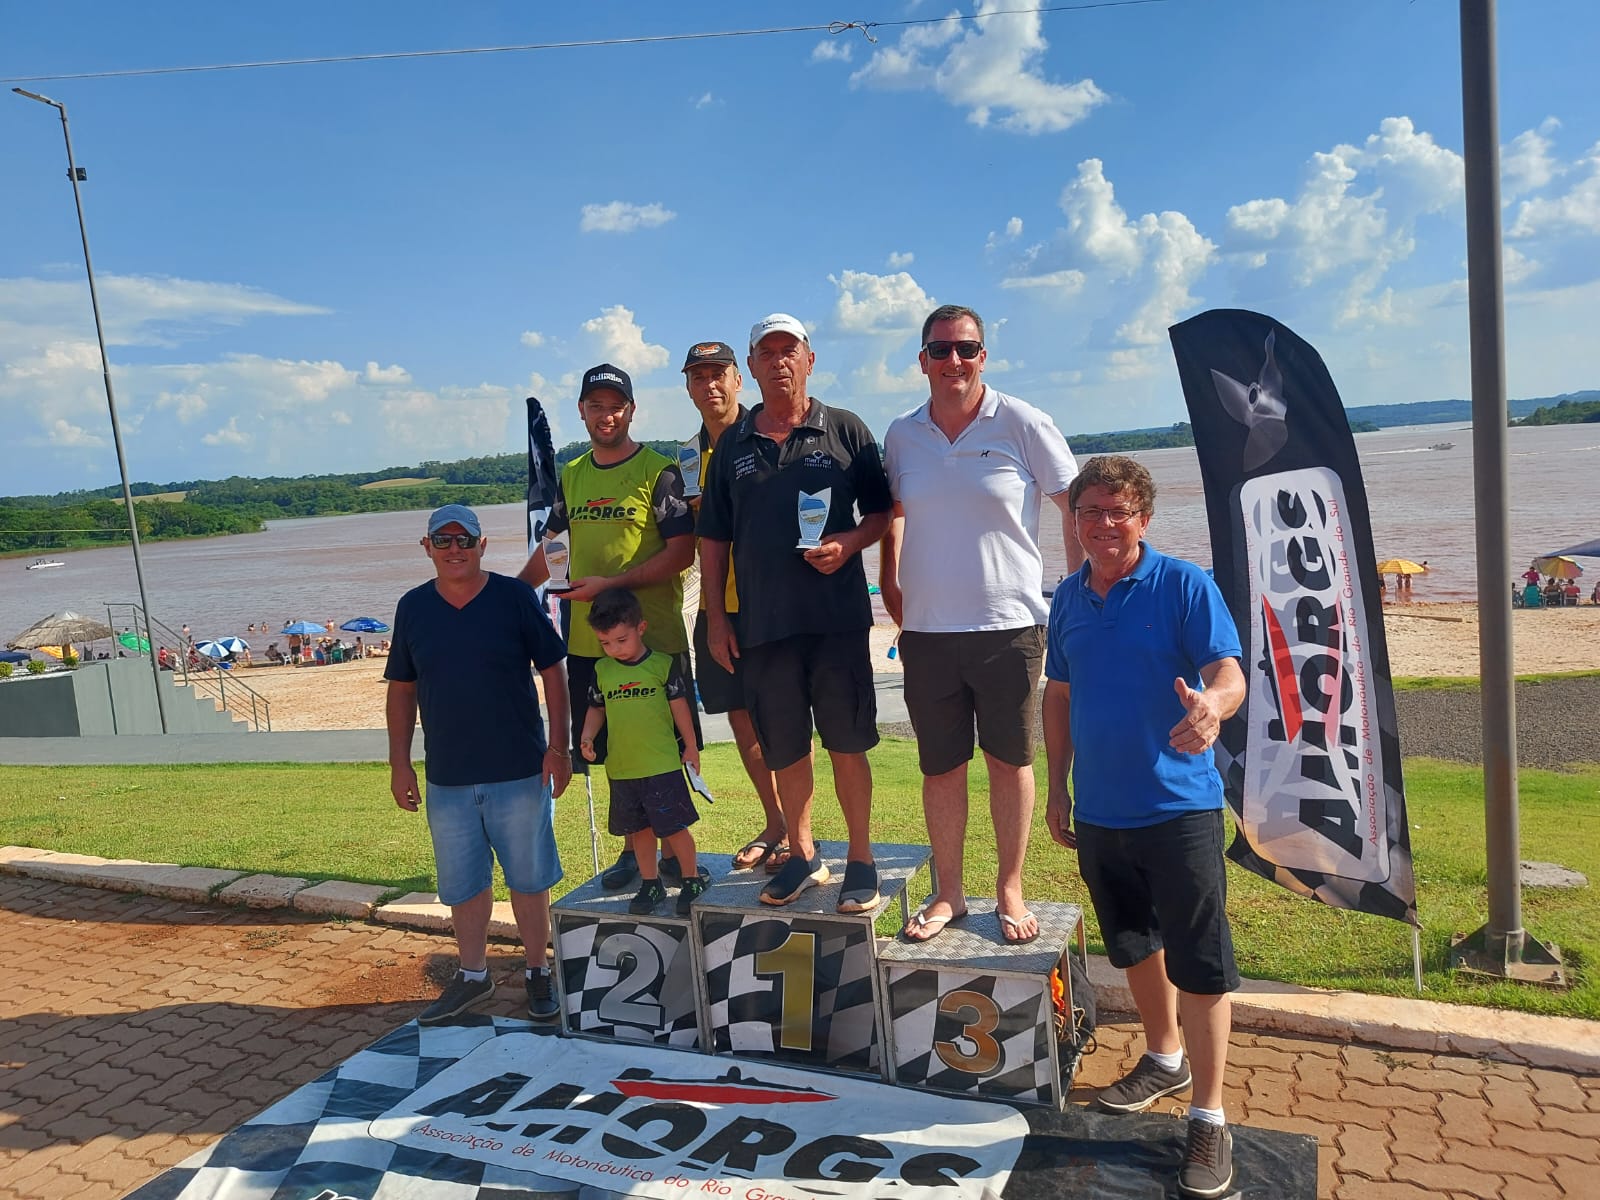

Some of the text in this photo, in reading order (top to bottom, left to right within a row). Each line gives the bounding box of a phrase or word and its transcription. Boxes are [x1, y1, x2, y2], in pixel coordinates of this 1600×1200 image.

[1327, 499, 1378, 847] Associação de Motonáutica do Rio Grande do Sul
[595, 932, 665, 1029] 2
[753, 931, 817, 1051] 1
[934, 990, 1002, 1073] 3
[416, 1122, 503, 1151] Associação
[511, 1143, 537, 1157] de
[543, 1149, 655, 1182] Motonáutica
[664, 1174, 690, 1189] do
[700, 1178, 731, 1196] Rio
